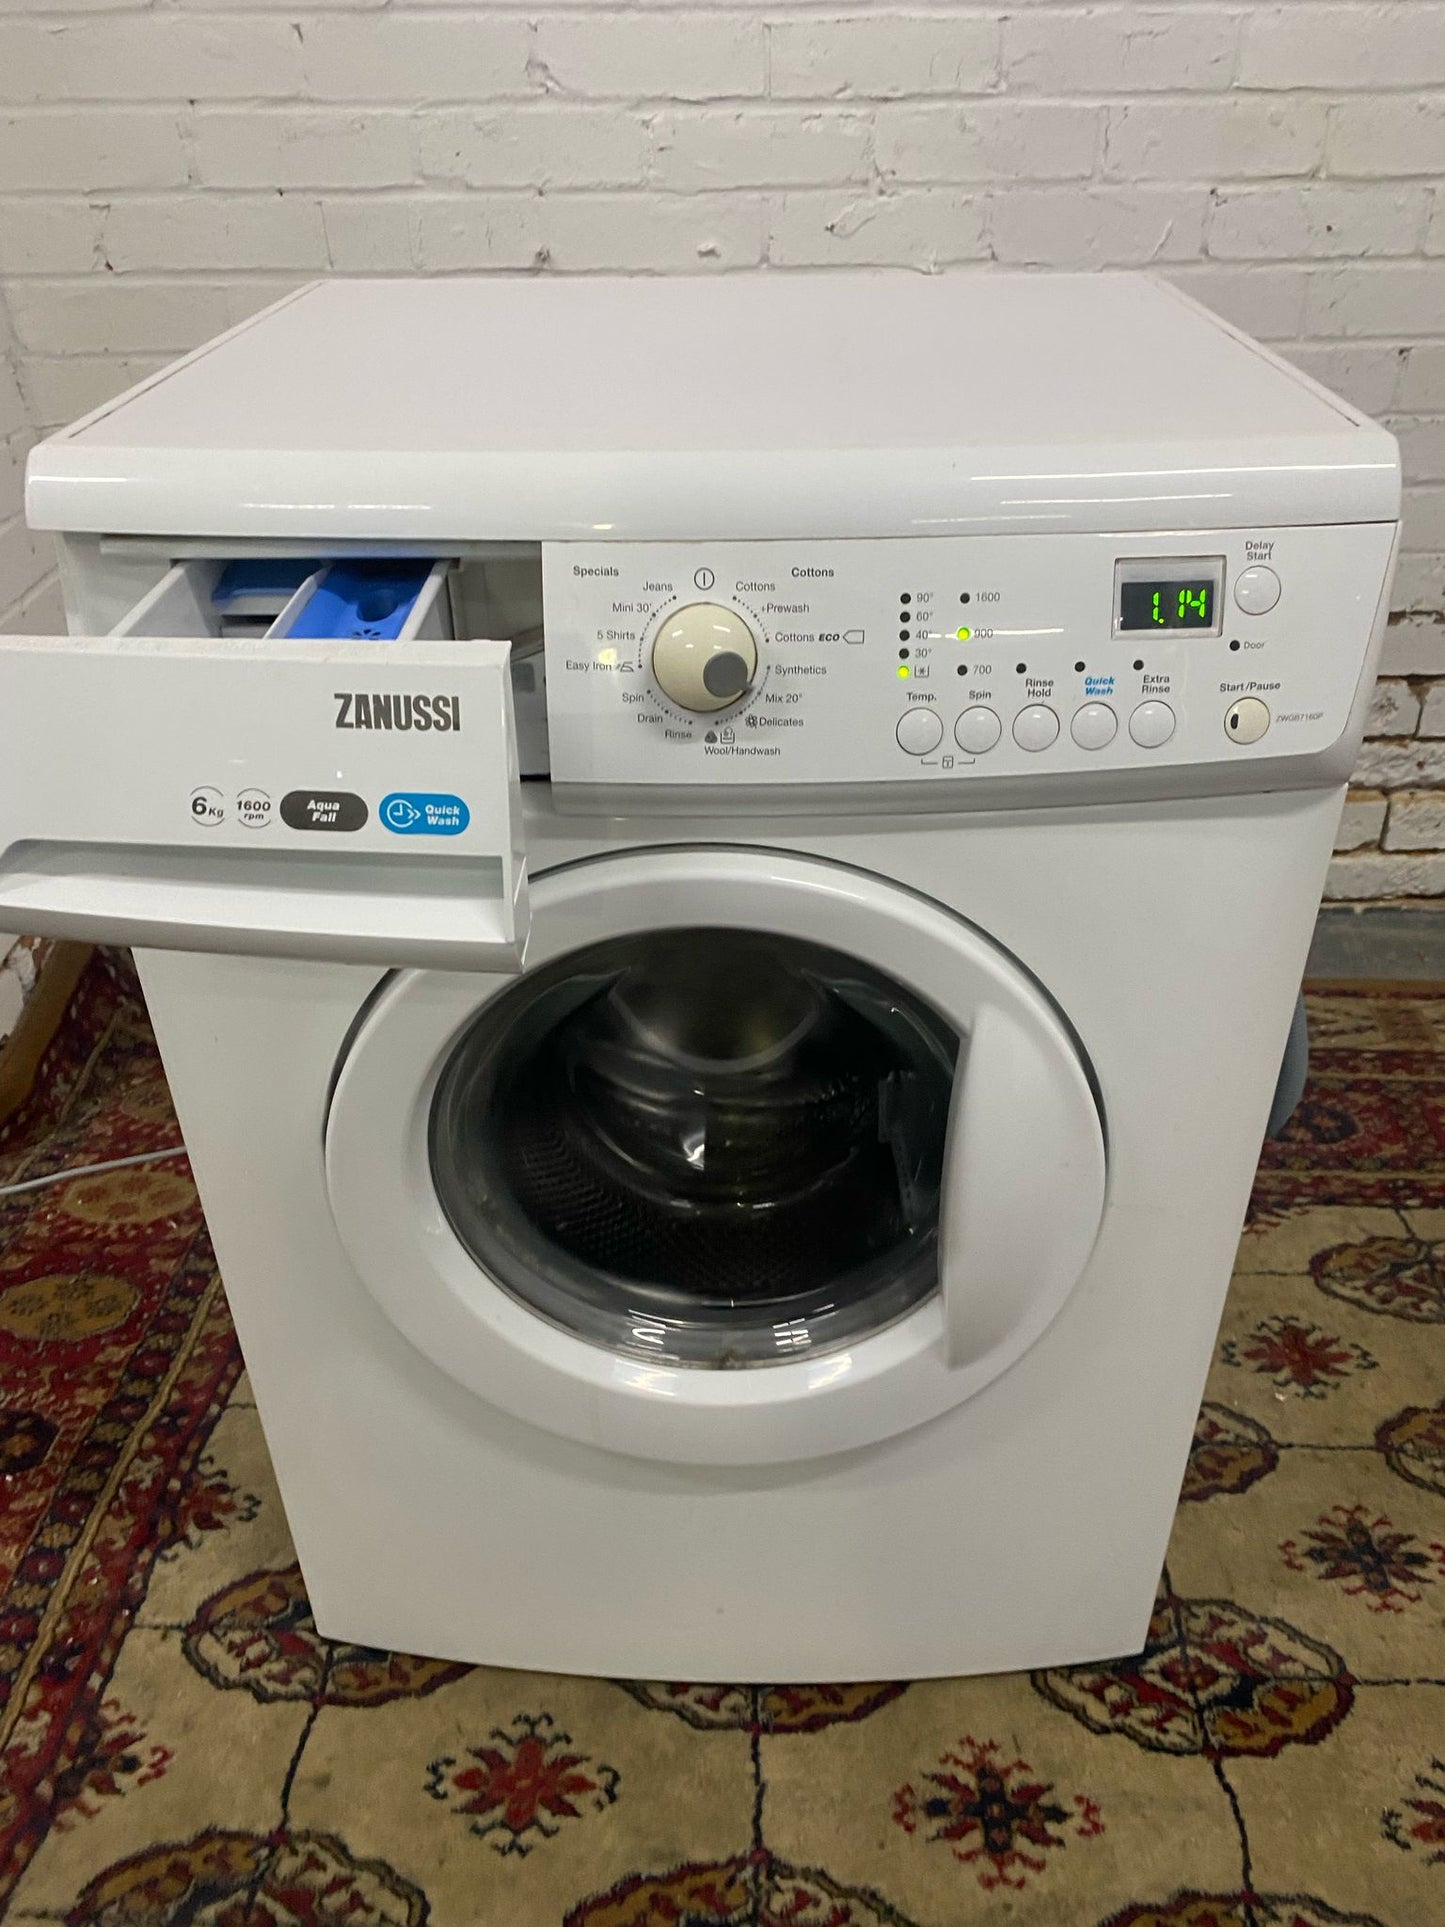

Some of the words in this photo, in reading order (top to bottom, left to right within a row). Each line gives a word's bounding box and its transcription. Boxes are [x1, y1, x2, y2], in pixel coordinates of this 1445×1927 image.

[1245, 541, 1275, 551] Delay
[1247, 551, 1272, 561] Start
[573, 566, 619, 578] Specials
[791, 567, 834, 577] Cottons
[643, 581, 673, 592] Jeans
[735, 582, 775, 592] Cottons
[976, 592, 1000, 602] 1600
[612, 603, 634, 613] Mini
[597, 630, 603, 640] 5
[607, 630, 635, 640] Shirts
[775, 631, 814, 643] Cottons
[818, 633, 840, 642] ECO
[974, 629, 993, 639] 900
[1243, 641, 1265, 650] Door
[566, 660, 589, 673] Easy
[593, 661, 612, 671] Iron
[775, 664, 827, 677] Synthetics
[973, 665, 991, 674] 700
[1025, 678, 1054, 688] Rinse
[1084, 676, 1114, 687] Quick
[1143, 675, 1170, 684] Extra
[1027, 687, 1051, 697] Hold
[1085, 686, 1113, 696] Wash
[1142, 684, 1170, 694] Rinse
[1219, 682, 1281, 692] Start/Pause
[622, 693, 644, 705] Spin
[765, 693, 783, 703] Mix
[906, 692, 937, 702] Temp.
[969, 690, 991, 700] Spin
[334, 693, 461, 731] ZANUSSI
[637, 714, 663, 724] Drain
[759, 717, 804, 727] Delicates
[665, 730, 692, 740] Rinse
[704, 746, 781, 756] Wool/Handwash
[191, 796, 207, 815] 6
[209, 806, 223, 818] Kg
[237, 800, 271, 812] 1600
[307, 800, 340, 812] Aqua
[425, 804, 460, 816] Quick
[243, 812, 264, 821] rpm
[312, 811, 336, 822] Fall
[427, 815, 459, 826] Wash
